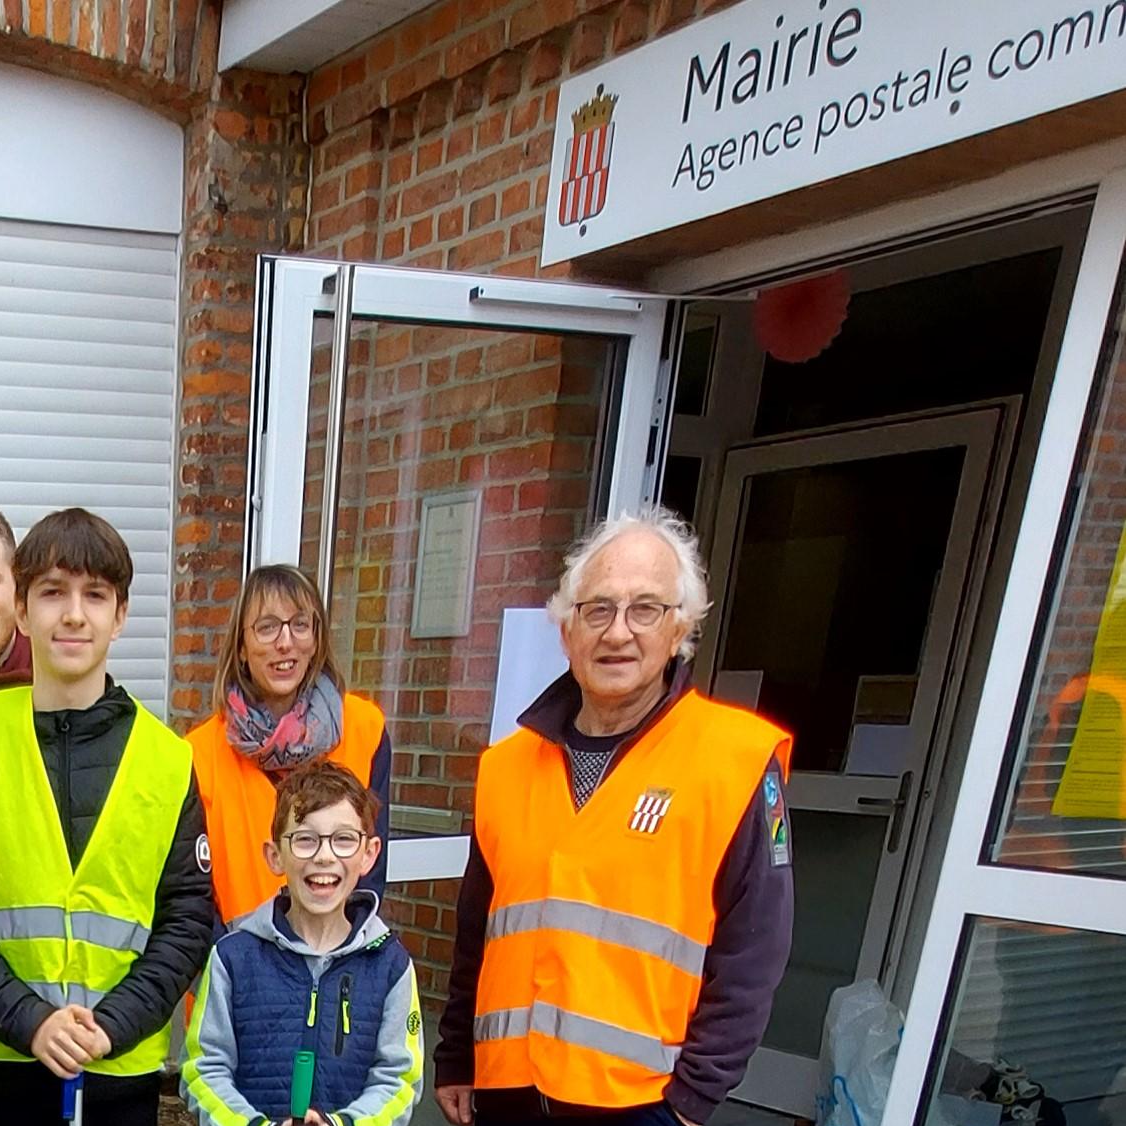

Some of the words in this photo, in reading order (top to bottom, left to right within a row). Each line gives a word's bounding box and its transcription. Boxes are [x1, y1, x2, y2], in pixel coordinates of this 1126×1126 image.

[672, 115, 802, 191] Agence
[813, 47, 972, 154] postale
[681, 0, 862, 123] Mairie
